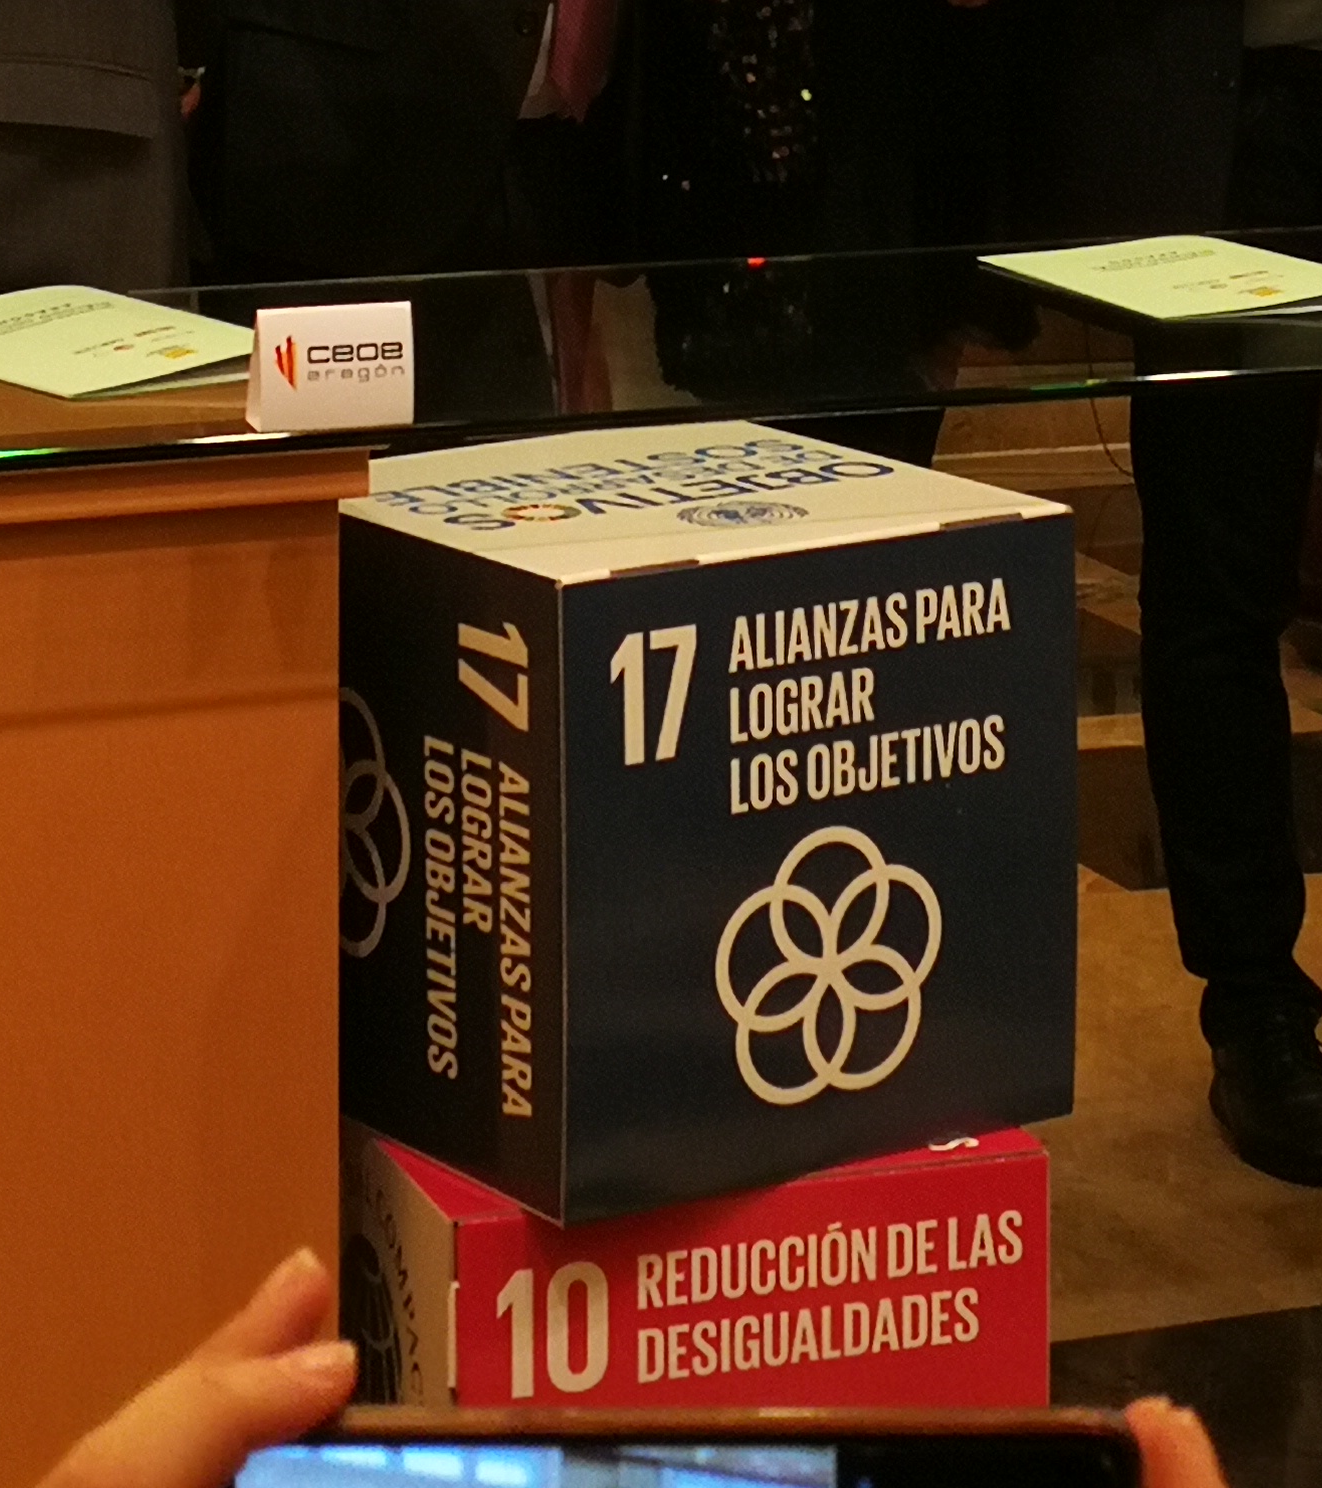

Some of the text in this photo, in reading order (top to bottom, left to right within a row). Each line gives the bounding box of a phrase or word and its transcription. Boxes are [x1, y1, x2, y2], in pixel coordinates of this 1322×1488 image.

[443, 461, 895, 531] OBJETIVOS
[457, 621, 529, 733] 17
[728, 577, 1011, 674] ALIANZAS PARA
[609, 623, 698, 767] 17
[729, 667, 875, 744] LOGRAR
[730, 714, 1006, 815] LOS OBJETIVOS
[461, 748, 492, 934] LOGRAR
[424, 735, 459, 1080] LOS OBJETIVOS
[499, 761, 533, 1118] ALIANZAS PARA
[637, 1209, 1023, 1310] REDUCCIÓN DE LAS
[495, 1260, 609, 1399] 10
[637, 1287, 980, 1384] DESIGUALDADES
